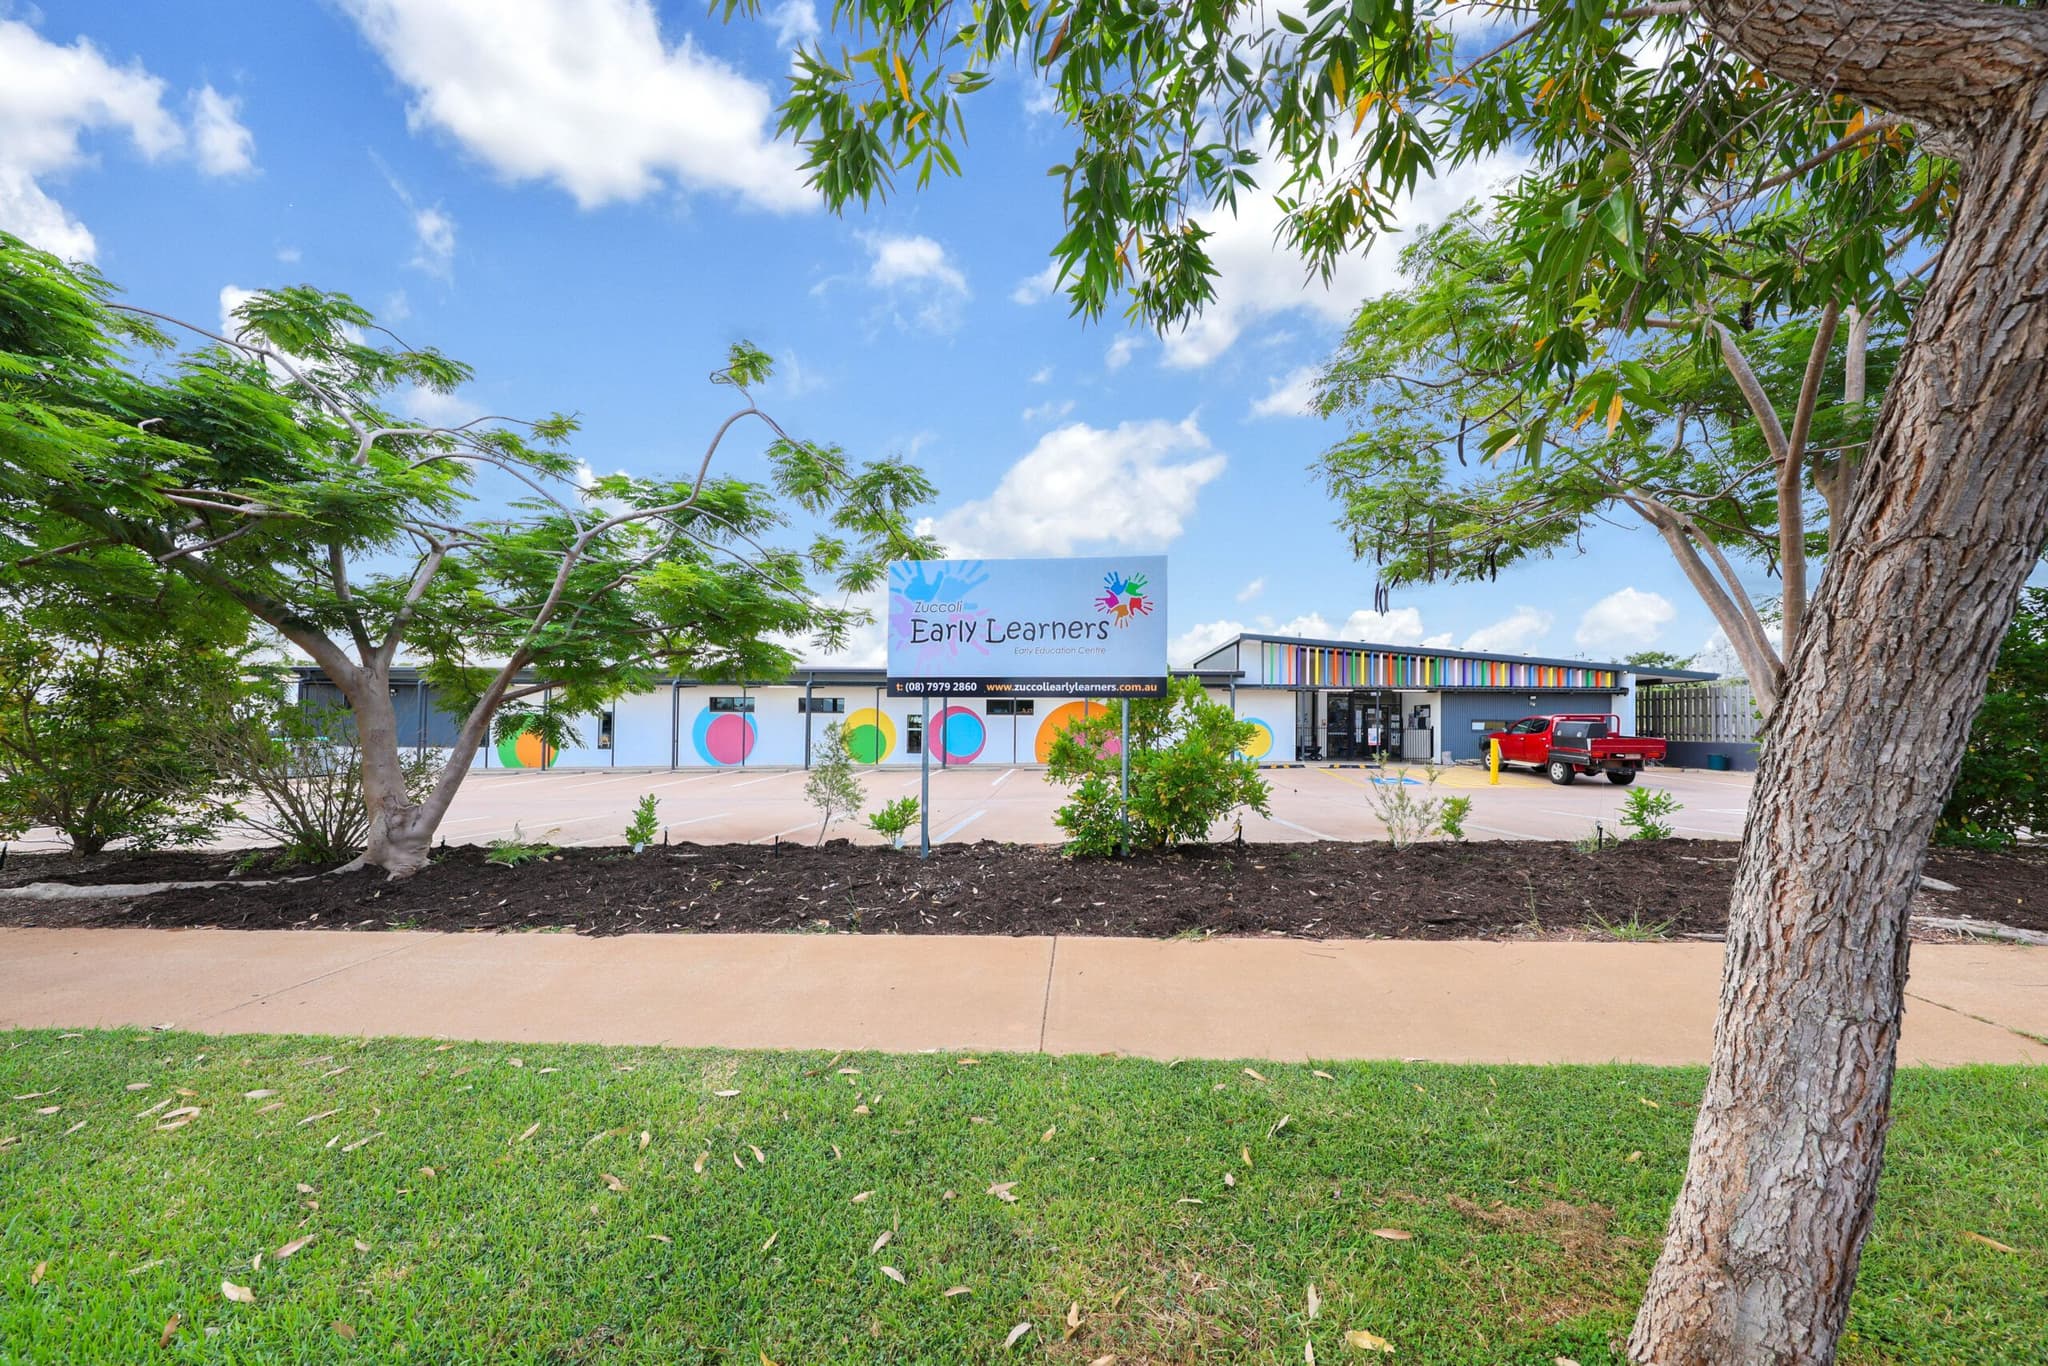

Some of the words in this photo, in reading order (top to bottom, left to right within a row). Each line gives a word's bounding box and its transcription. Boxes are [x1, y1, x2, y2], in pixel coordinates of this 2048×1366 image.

[914, 600, 963, 613] Zuccoli
[910, 618, 977, 644] Early
[985, 618, 1110, 643] Learners
[1014, 646, 1033, 655] Early
[1034, 646, 1076, 655] Education
[1078, 646, 1106, 655] Centre
[905, 681, 924, 692] (08)
[927, 682, 951, 692] 7979
[953, 682, 977, 692] 2860
[986, 682, 1157, 693] www.zuccoliearlylearners.com.au
